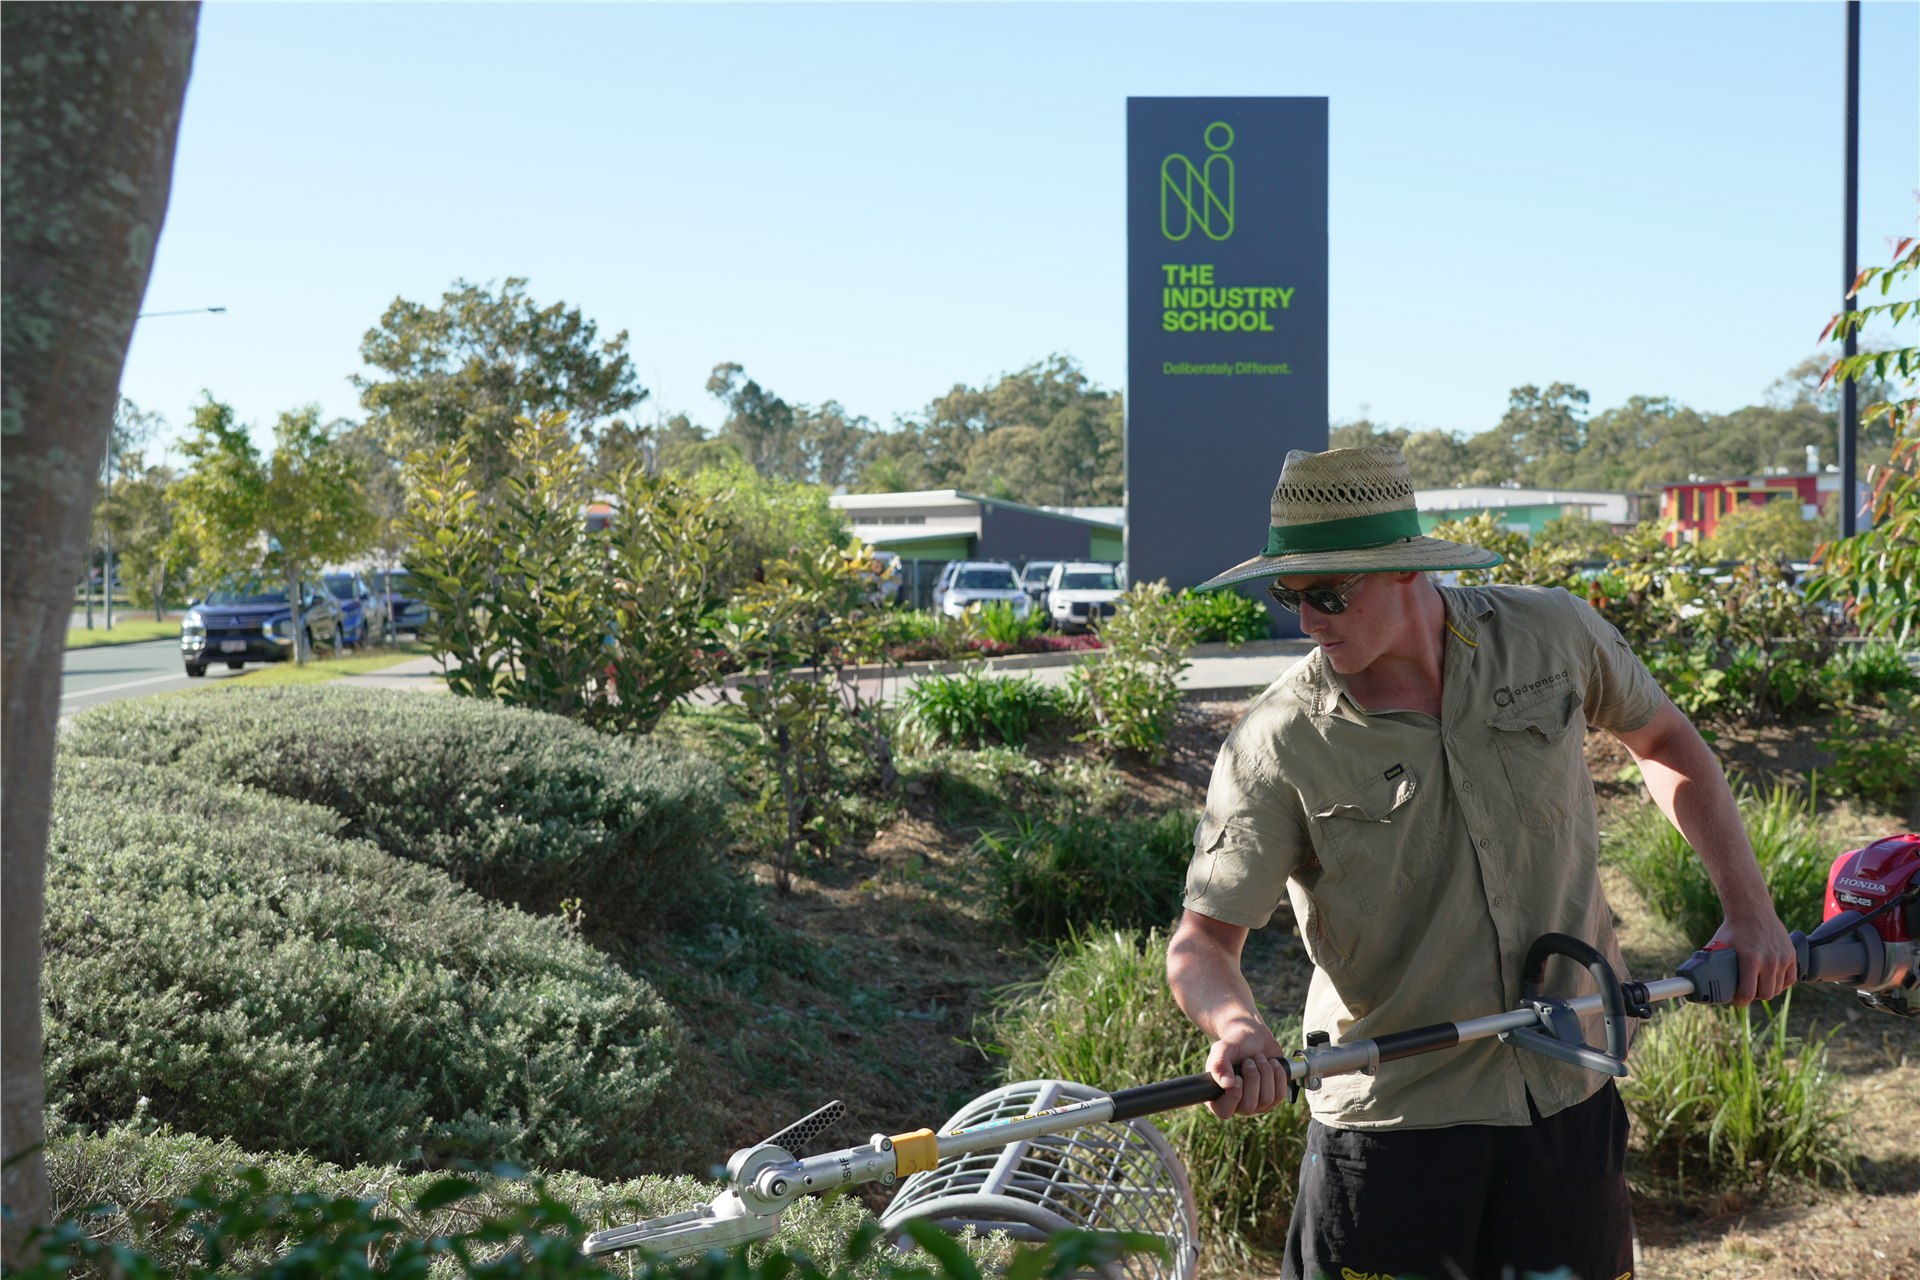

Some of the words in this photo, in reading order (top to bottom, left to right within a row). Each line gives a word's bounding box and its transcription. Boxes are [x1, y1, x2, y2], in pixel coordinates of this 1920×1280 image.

[1162, 264, 1214, 286] THE
[1163, 287, 1295, 309] INDUSTRY
[1162, 310, 1274, 332] SCHOOL
[1162, 361, 1233, 377] Deliberately
[1235, 361, 1293, 375] Different.
[1514, 669, 1568, 696] advanced
[1839, 877, 1887, 893] HONDA
